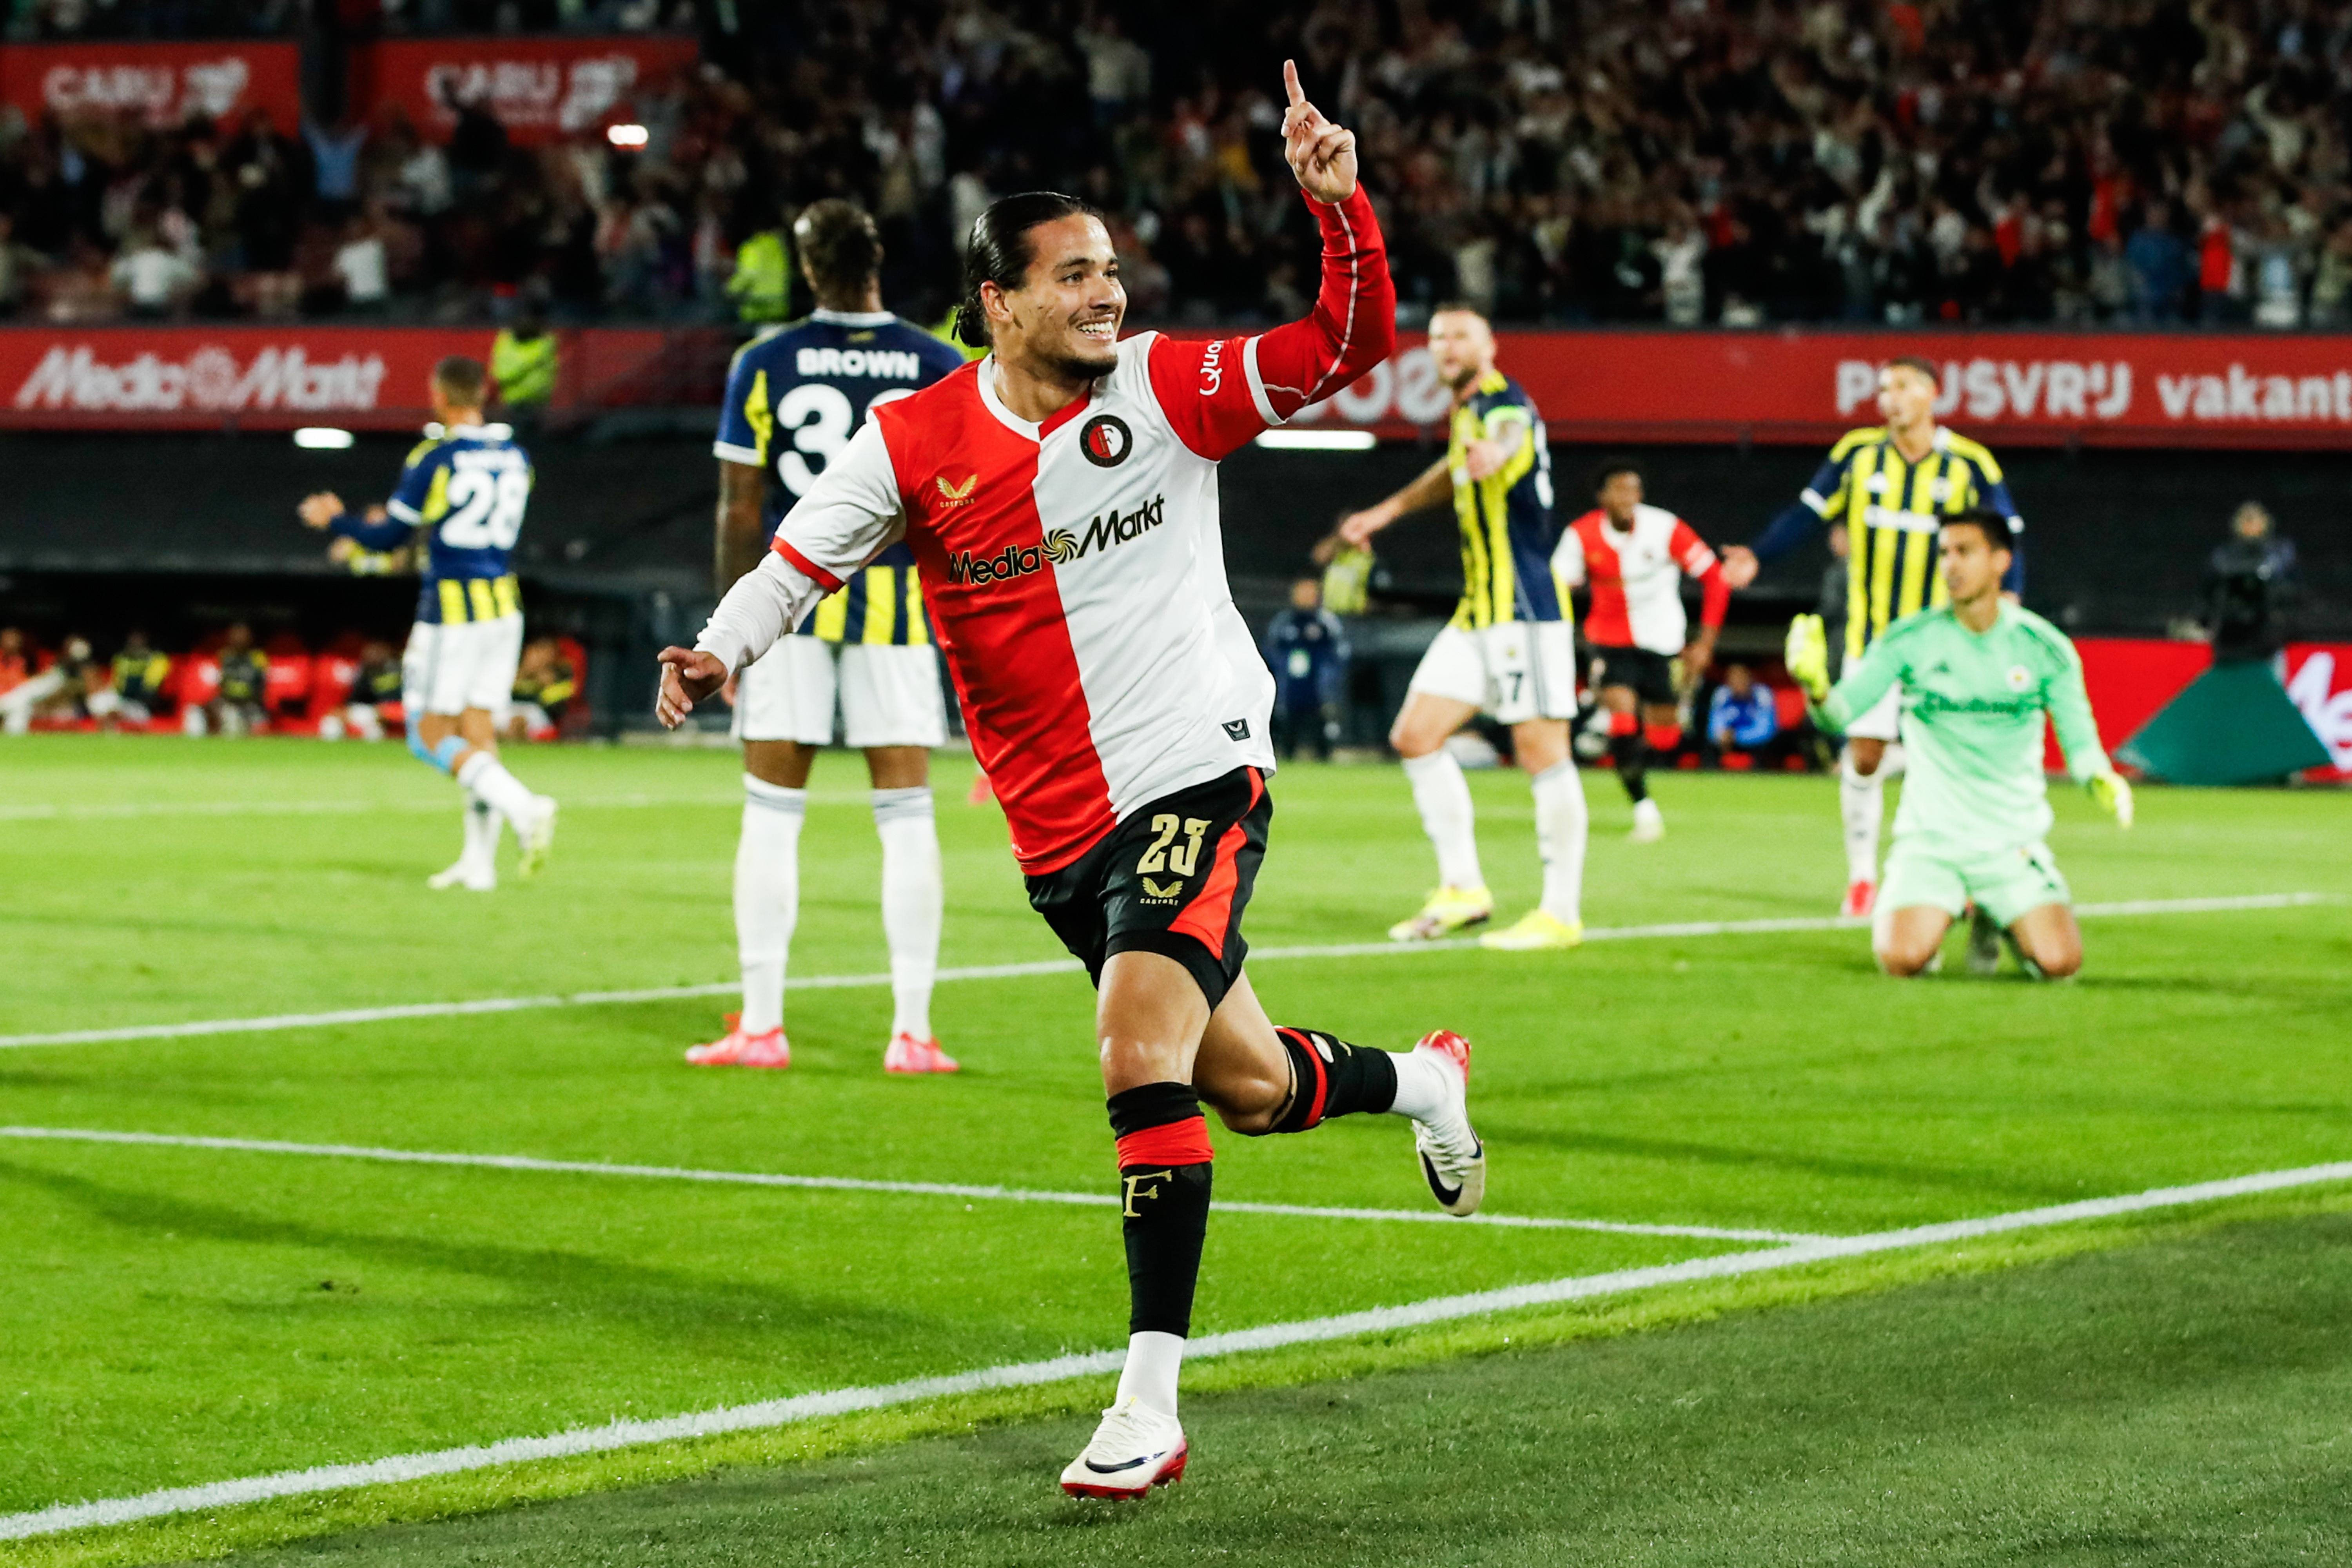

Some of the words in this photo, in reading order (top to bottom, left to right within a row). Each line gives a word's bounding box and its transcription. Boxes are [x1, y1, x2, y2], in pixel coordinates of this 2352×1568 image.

[797, 348, 919, 379] BROWN
[440, 470, 529, 549] 28
[947, 544, 1042, 585] Media
[1076, 493, 1165, 559] Markt
[1136, 813, 1212, 877] 23
[1123, 1169, 1172, 1217] F
